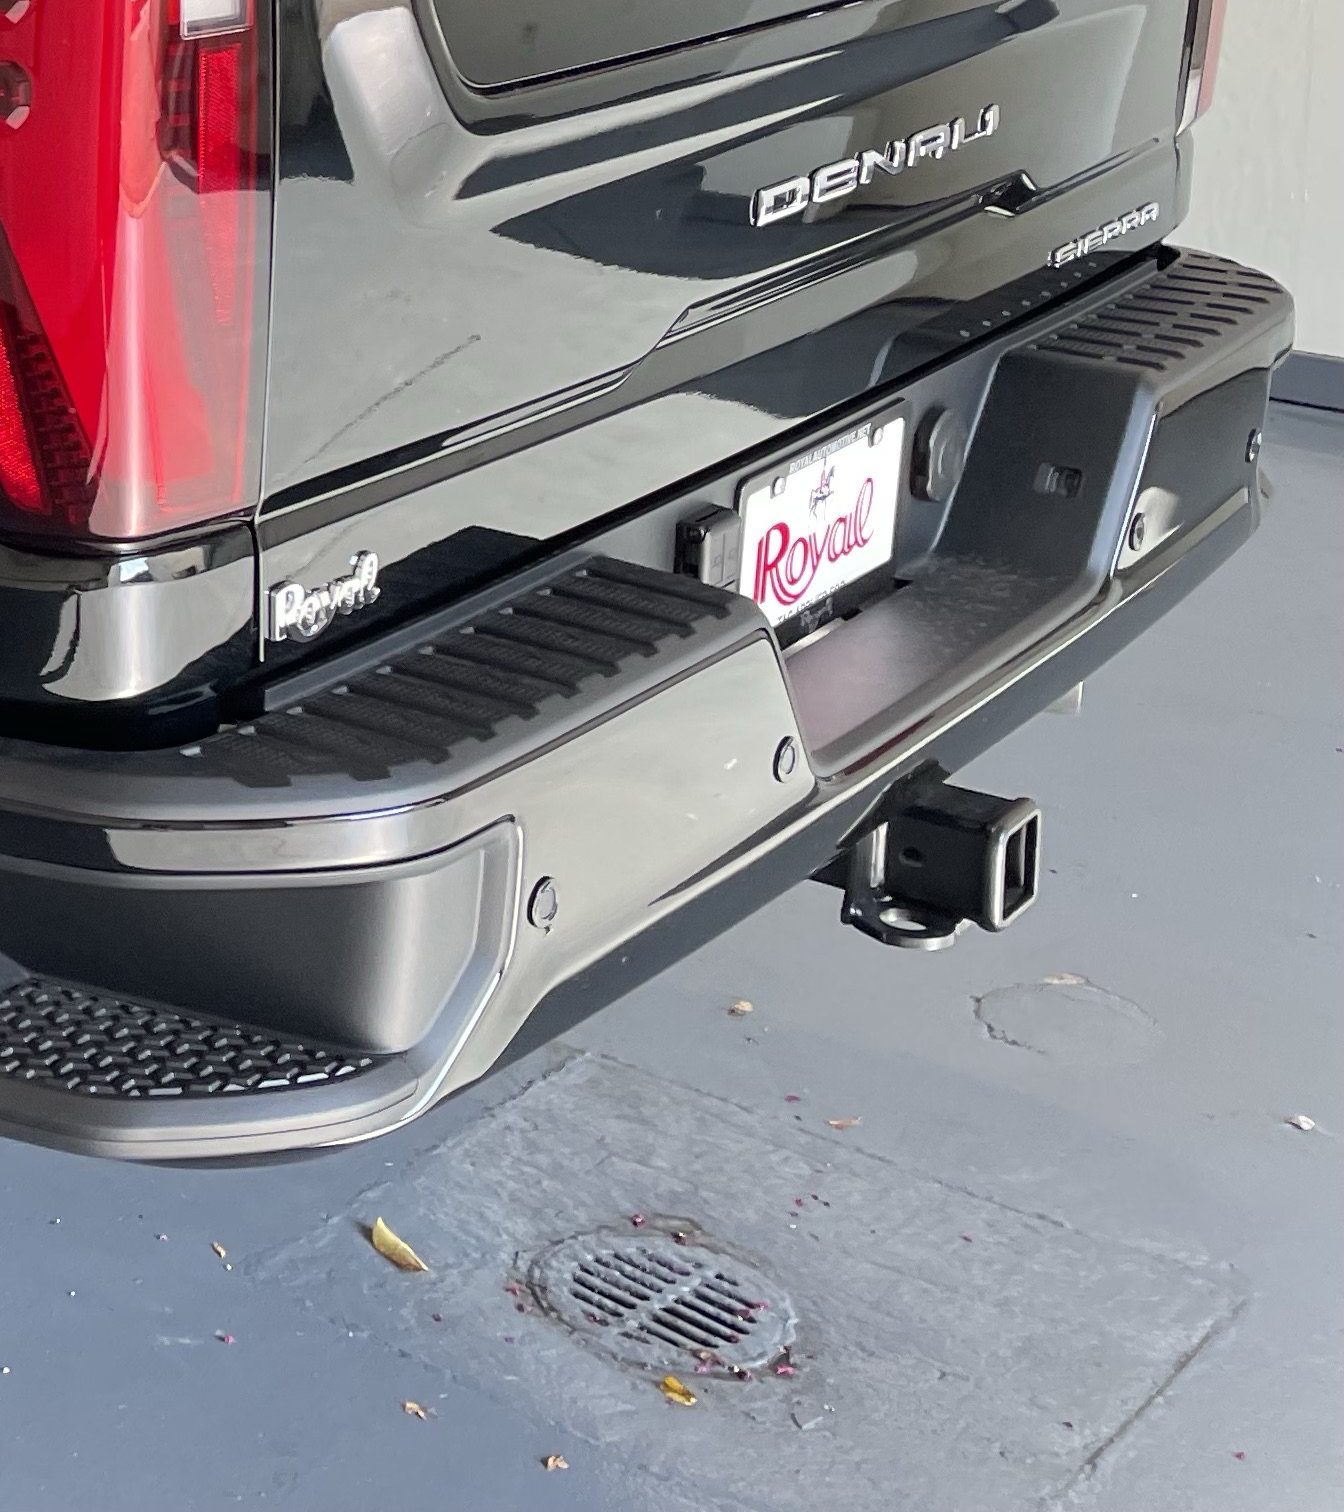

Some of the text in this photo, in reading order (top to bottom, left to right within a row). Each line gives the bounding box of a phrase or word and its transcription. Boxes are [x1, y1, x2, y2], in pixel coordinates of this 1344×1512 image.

[750, 103, 1000, 227] DENALI
[1048, 202, 1160, 268] SIERRA
[752, 477, 874, 606] Royal
